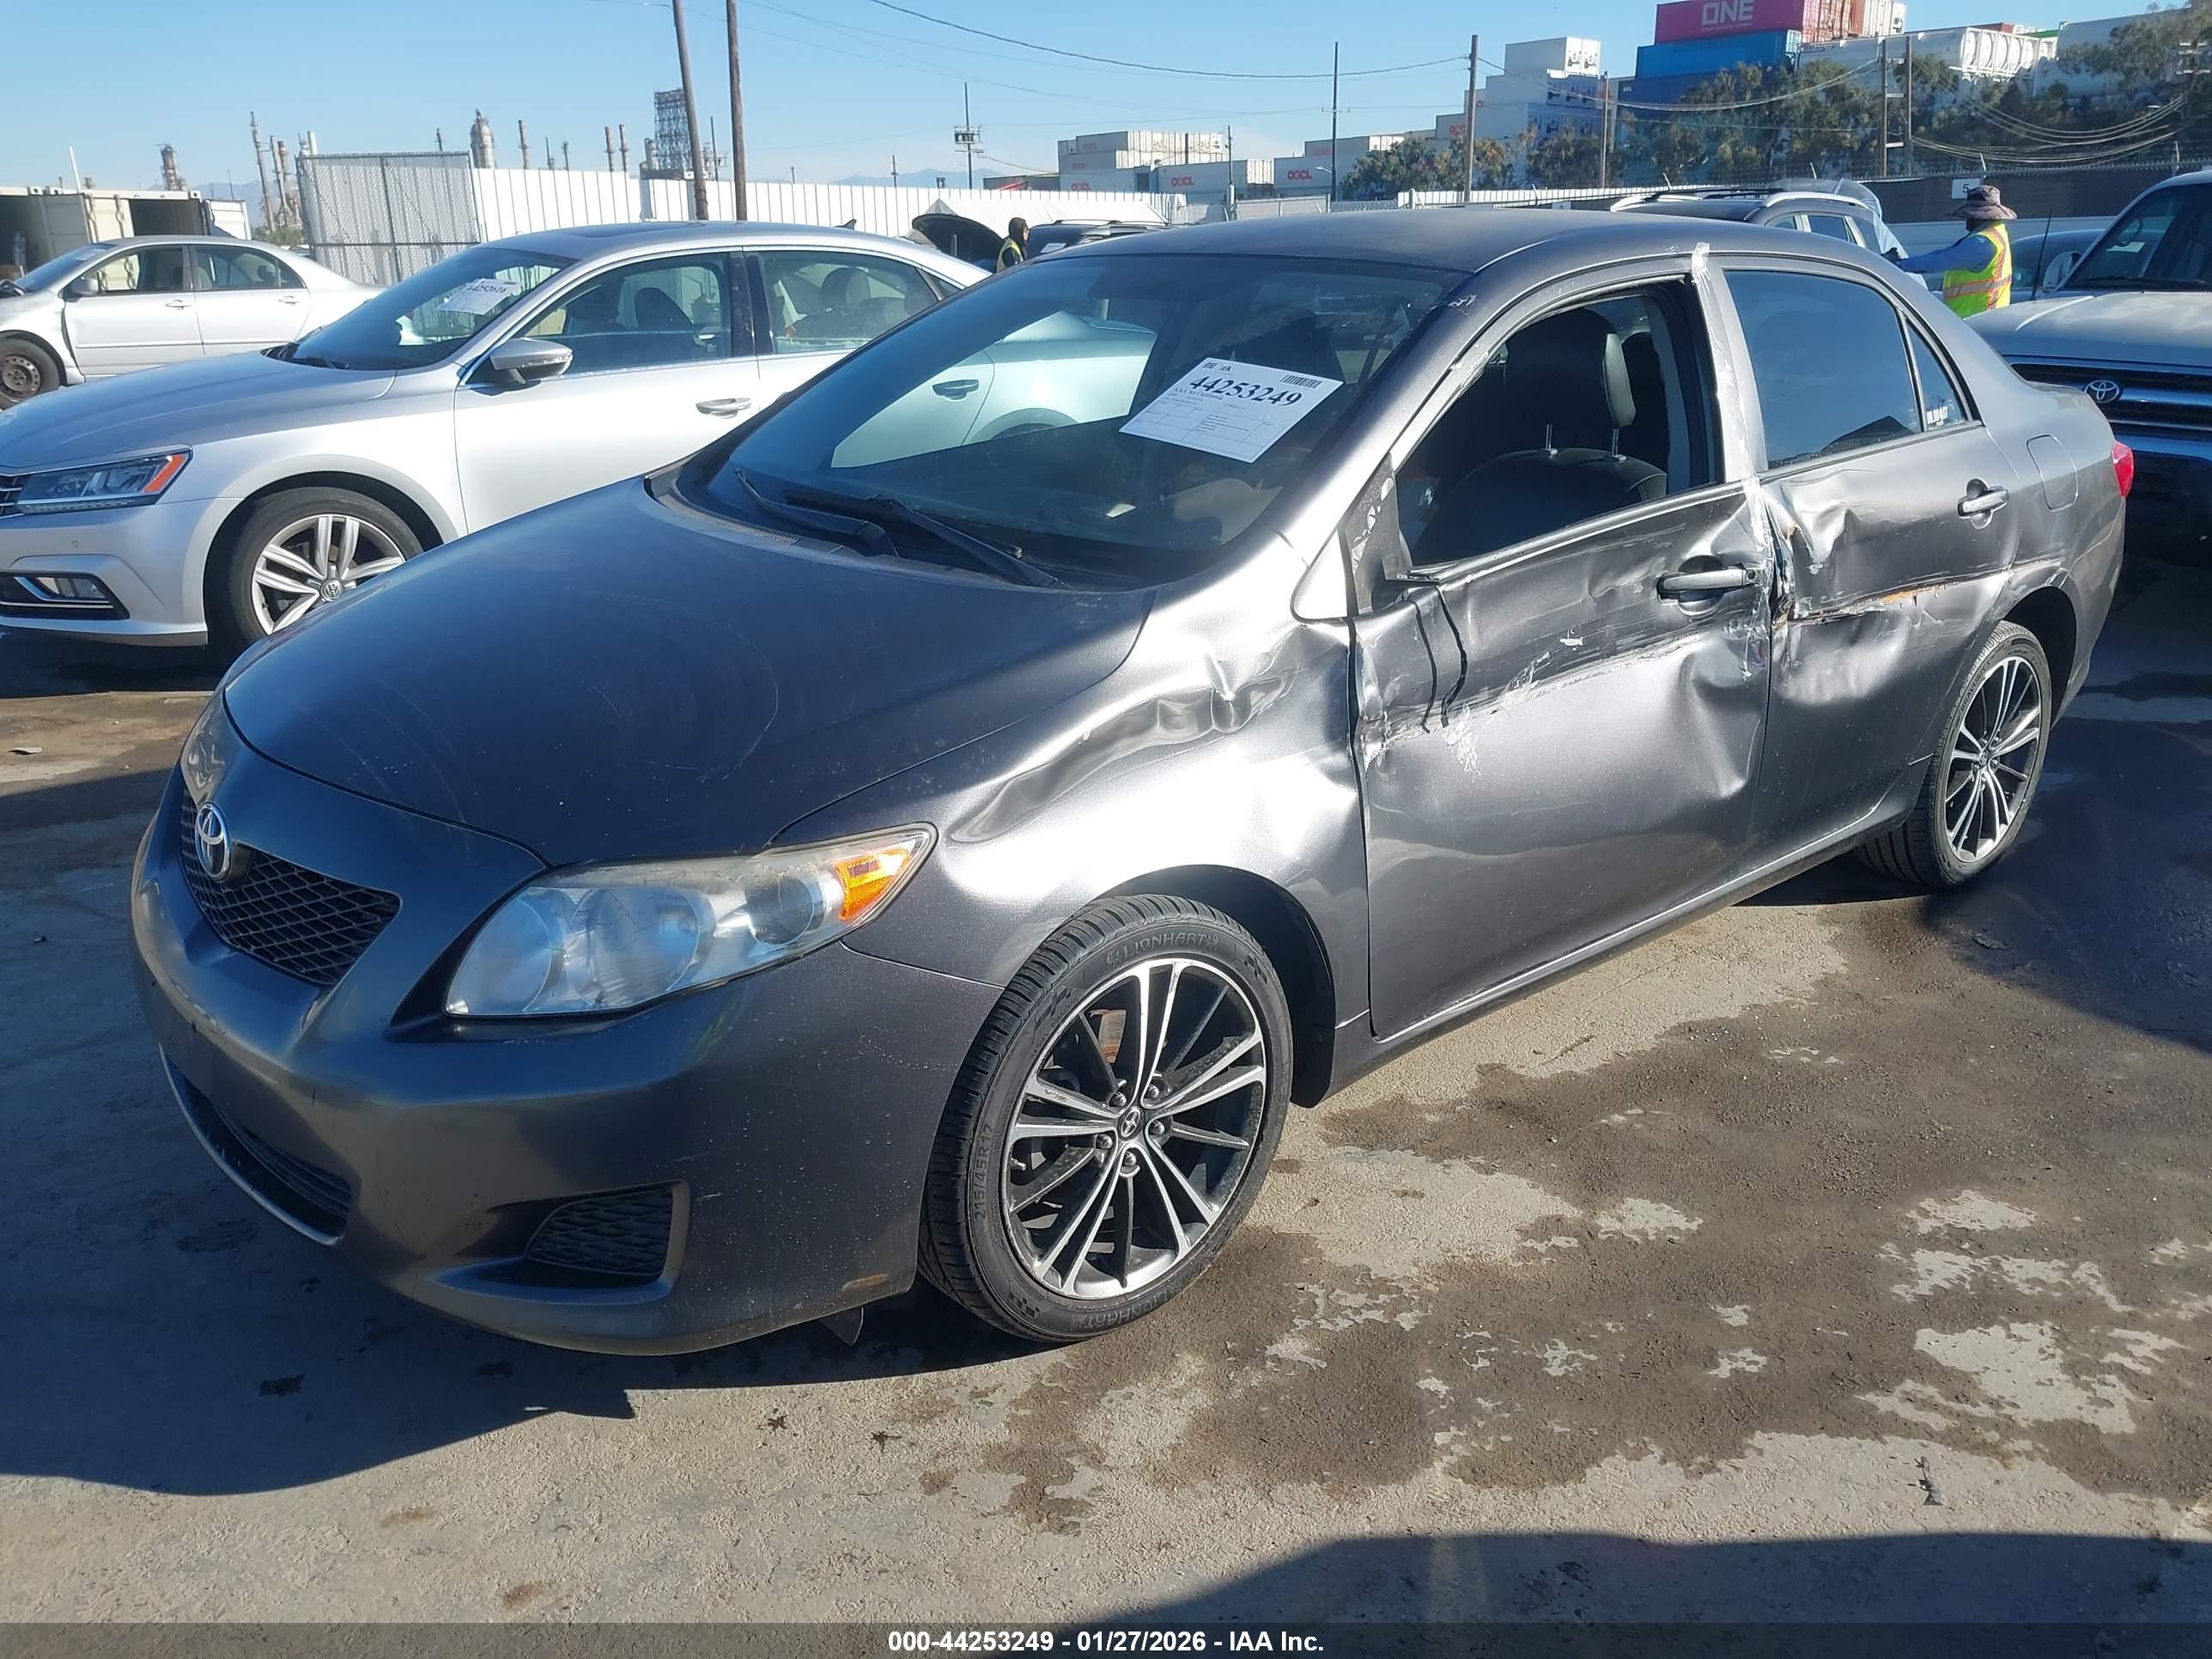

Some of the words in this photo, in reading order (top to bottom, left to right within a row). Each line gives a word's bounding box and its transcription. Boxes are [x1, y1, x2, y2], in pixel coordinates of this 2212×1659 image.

[1702, 0, 1753, 25] ONE
[1171, 176, 1194, 187] OOCL
[1189, 375, 1303, 407] 44253249
